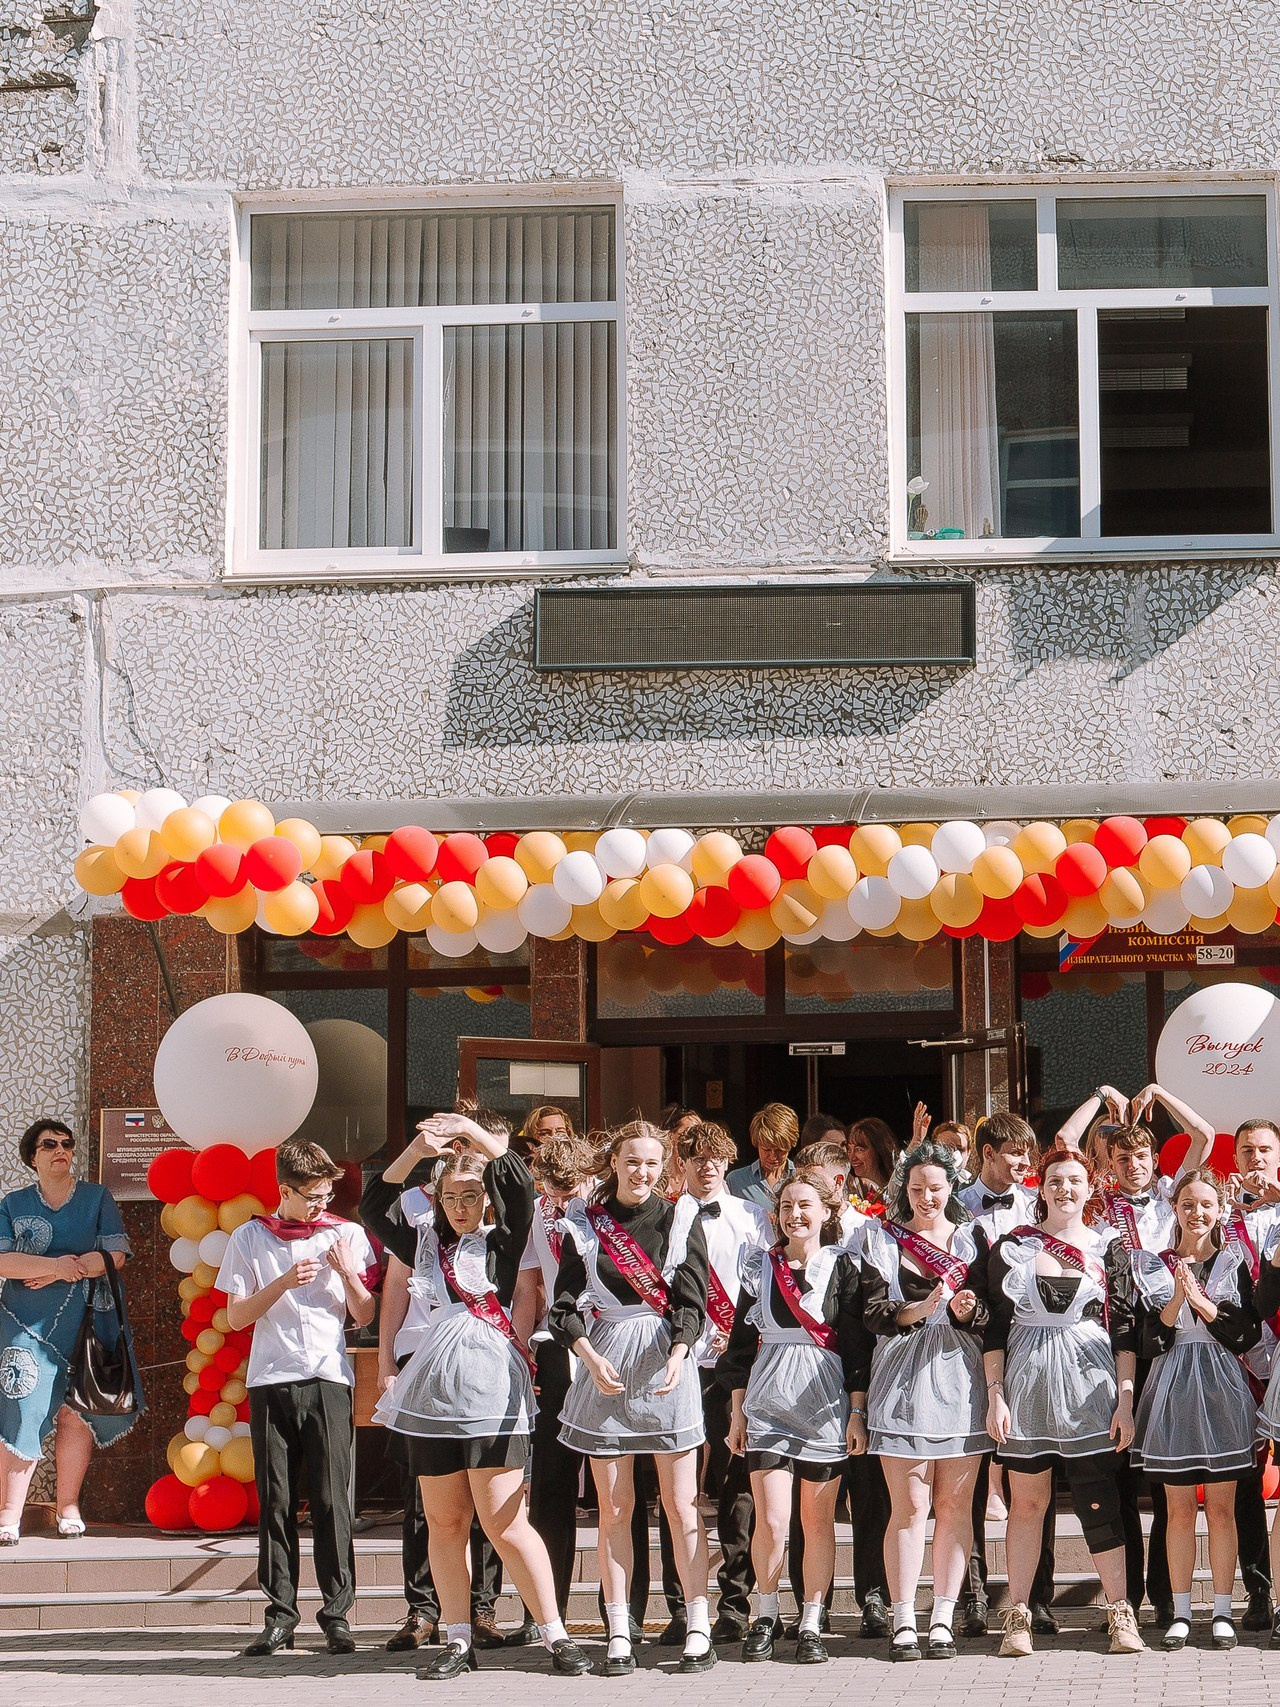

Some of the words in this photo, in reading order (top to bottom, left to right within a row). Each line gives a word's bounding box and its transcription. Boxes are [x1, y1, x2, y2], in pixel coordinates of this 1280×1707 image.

[1128, 935, 1205, 947] КОМИССИЯ
[1067, 954, 1144, 965] ИЗБИРАТЕЛЬНОГО
[1146, 953, 1184, 963] УЧАСТКА
[1197, 947, 1234, 960] 58-20
[1185, 1034, 1264, 1059] Выпуск
[224, 1047, 241, 1062] В
[241, 1047, 287, 1067] Добрый
[1202, 1062, 1254, 1076] 2024
[608, 1231, 661, 1296] Выпускница
